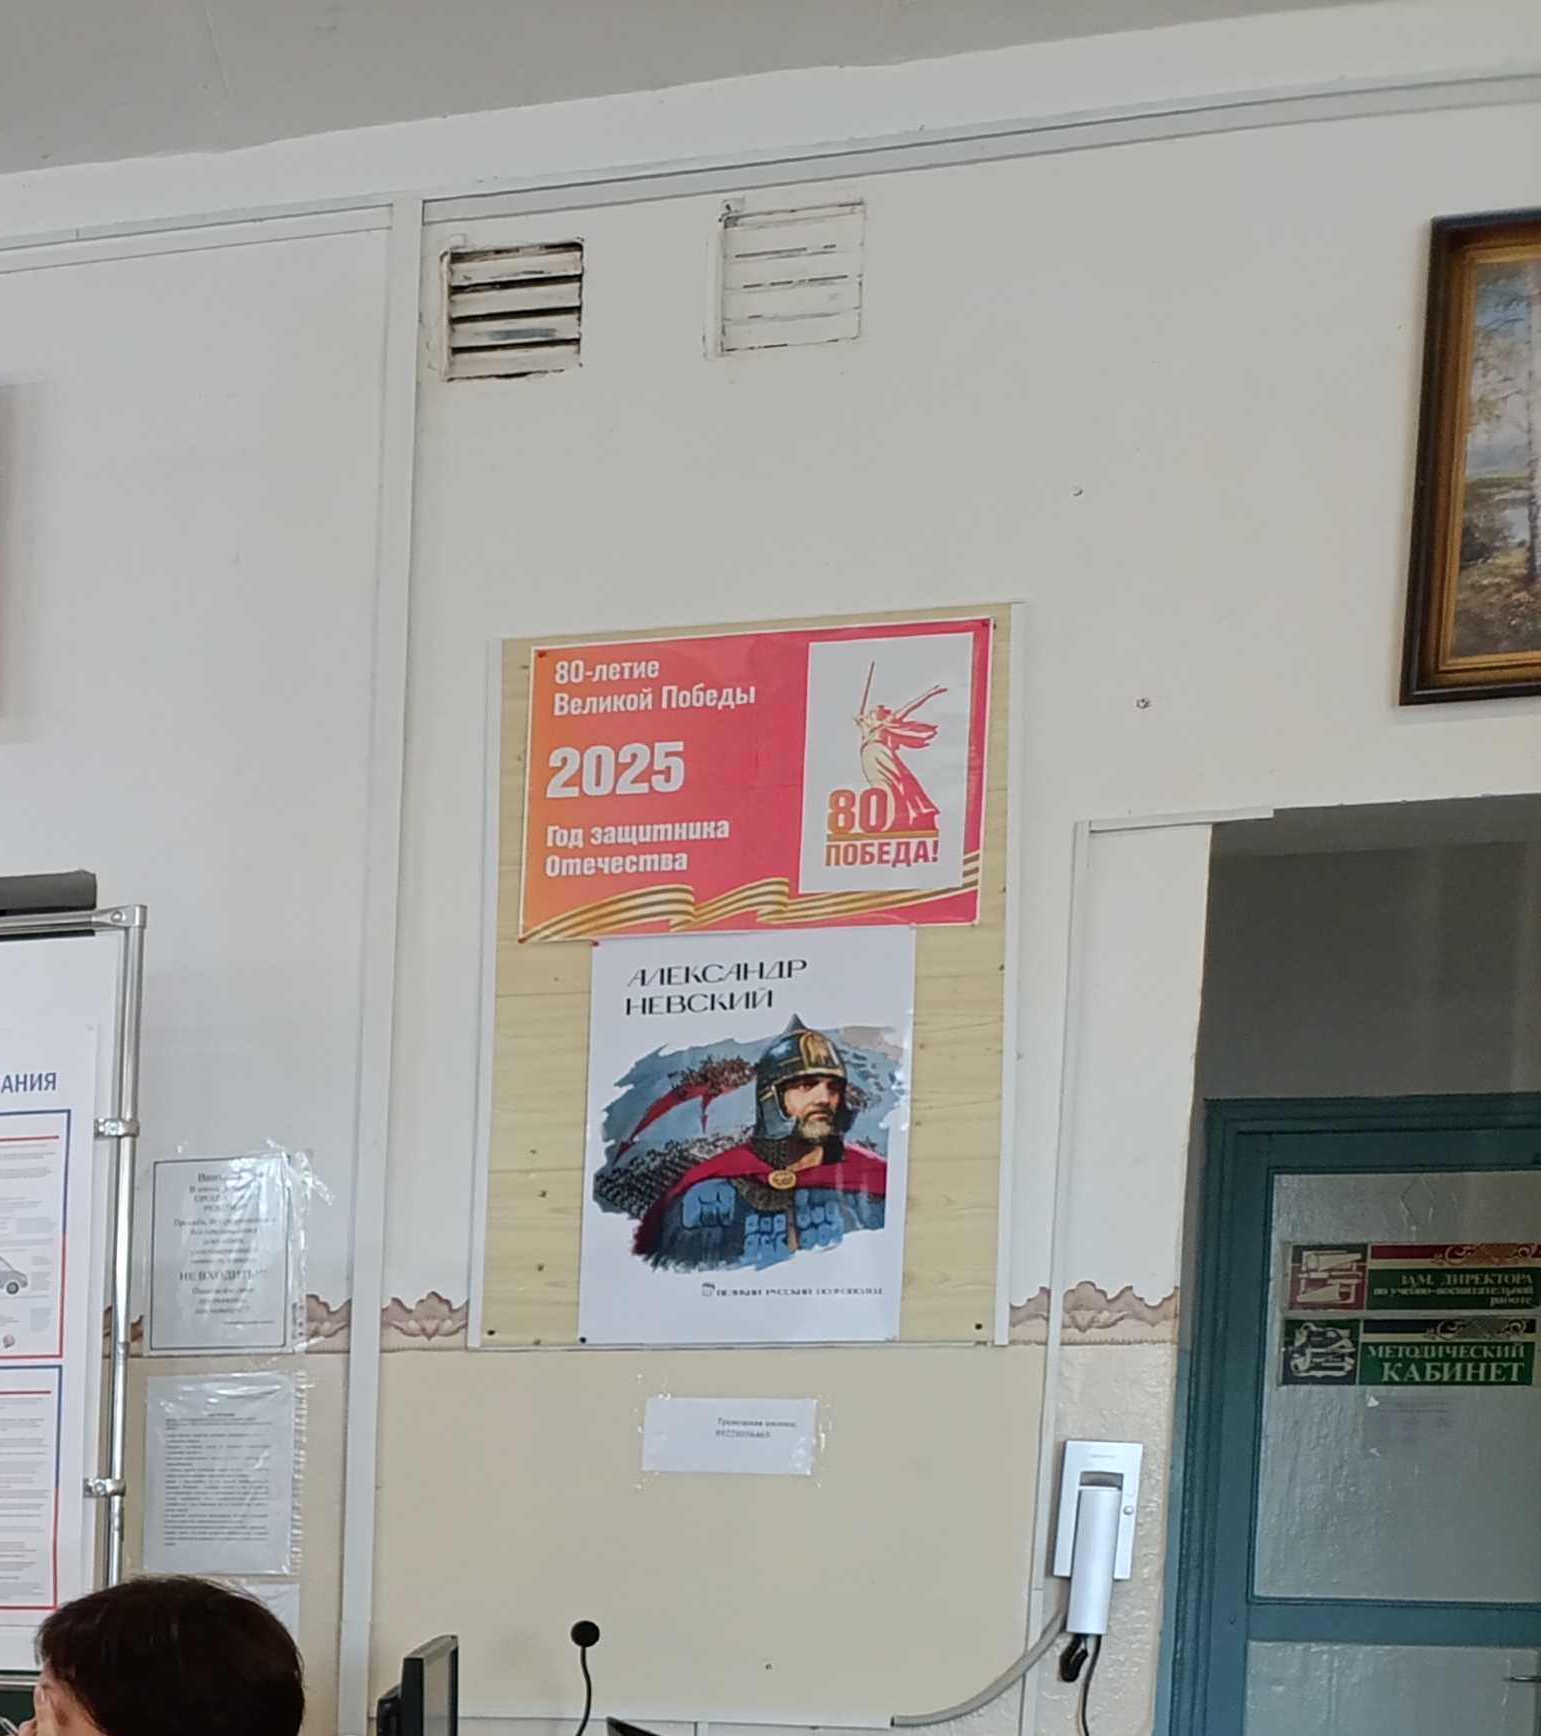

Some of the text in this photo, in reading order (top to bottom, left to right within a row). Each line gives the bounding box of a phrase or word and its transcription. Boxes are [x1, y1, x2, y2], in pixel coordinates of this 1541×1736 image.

[555, 660, 659, 684] 80-летие
[554, 683, 756, 716] Великой Победы
[546, 741, 685, 798] 2025
[827, 788, 889, 835] 80
[547, 819, 730, 848] Год защитника
[546, 852, 688, 877] Отечества
[826, 840, 939, 868] ПОБЕДА!
[627, 959, 807, 987] АЛЕКСАНДР
[625, 987, 773, 1016] НЕВСКИЙ
[1373, 1287, 1387, 1295] по
[1400, 1273, 1533, 1287] ЗАМ. ДИРЕКТОРА
[1367, 1343, 1525, 1359] МЕТОДИЧЕСКИЙ
[1382, 1363, 1525, 1382] КАБИНЕТ
